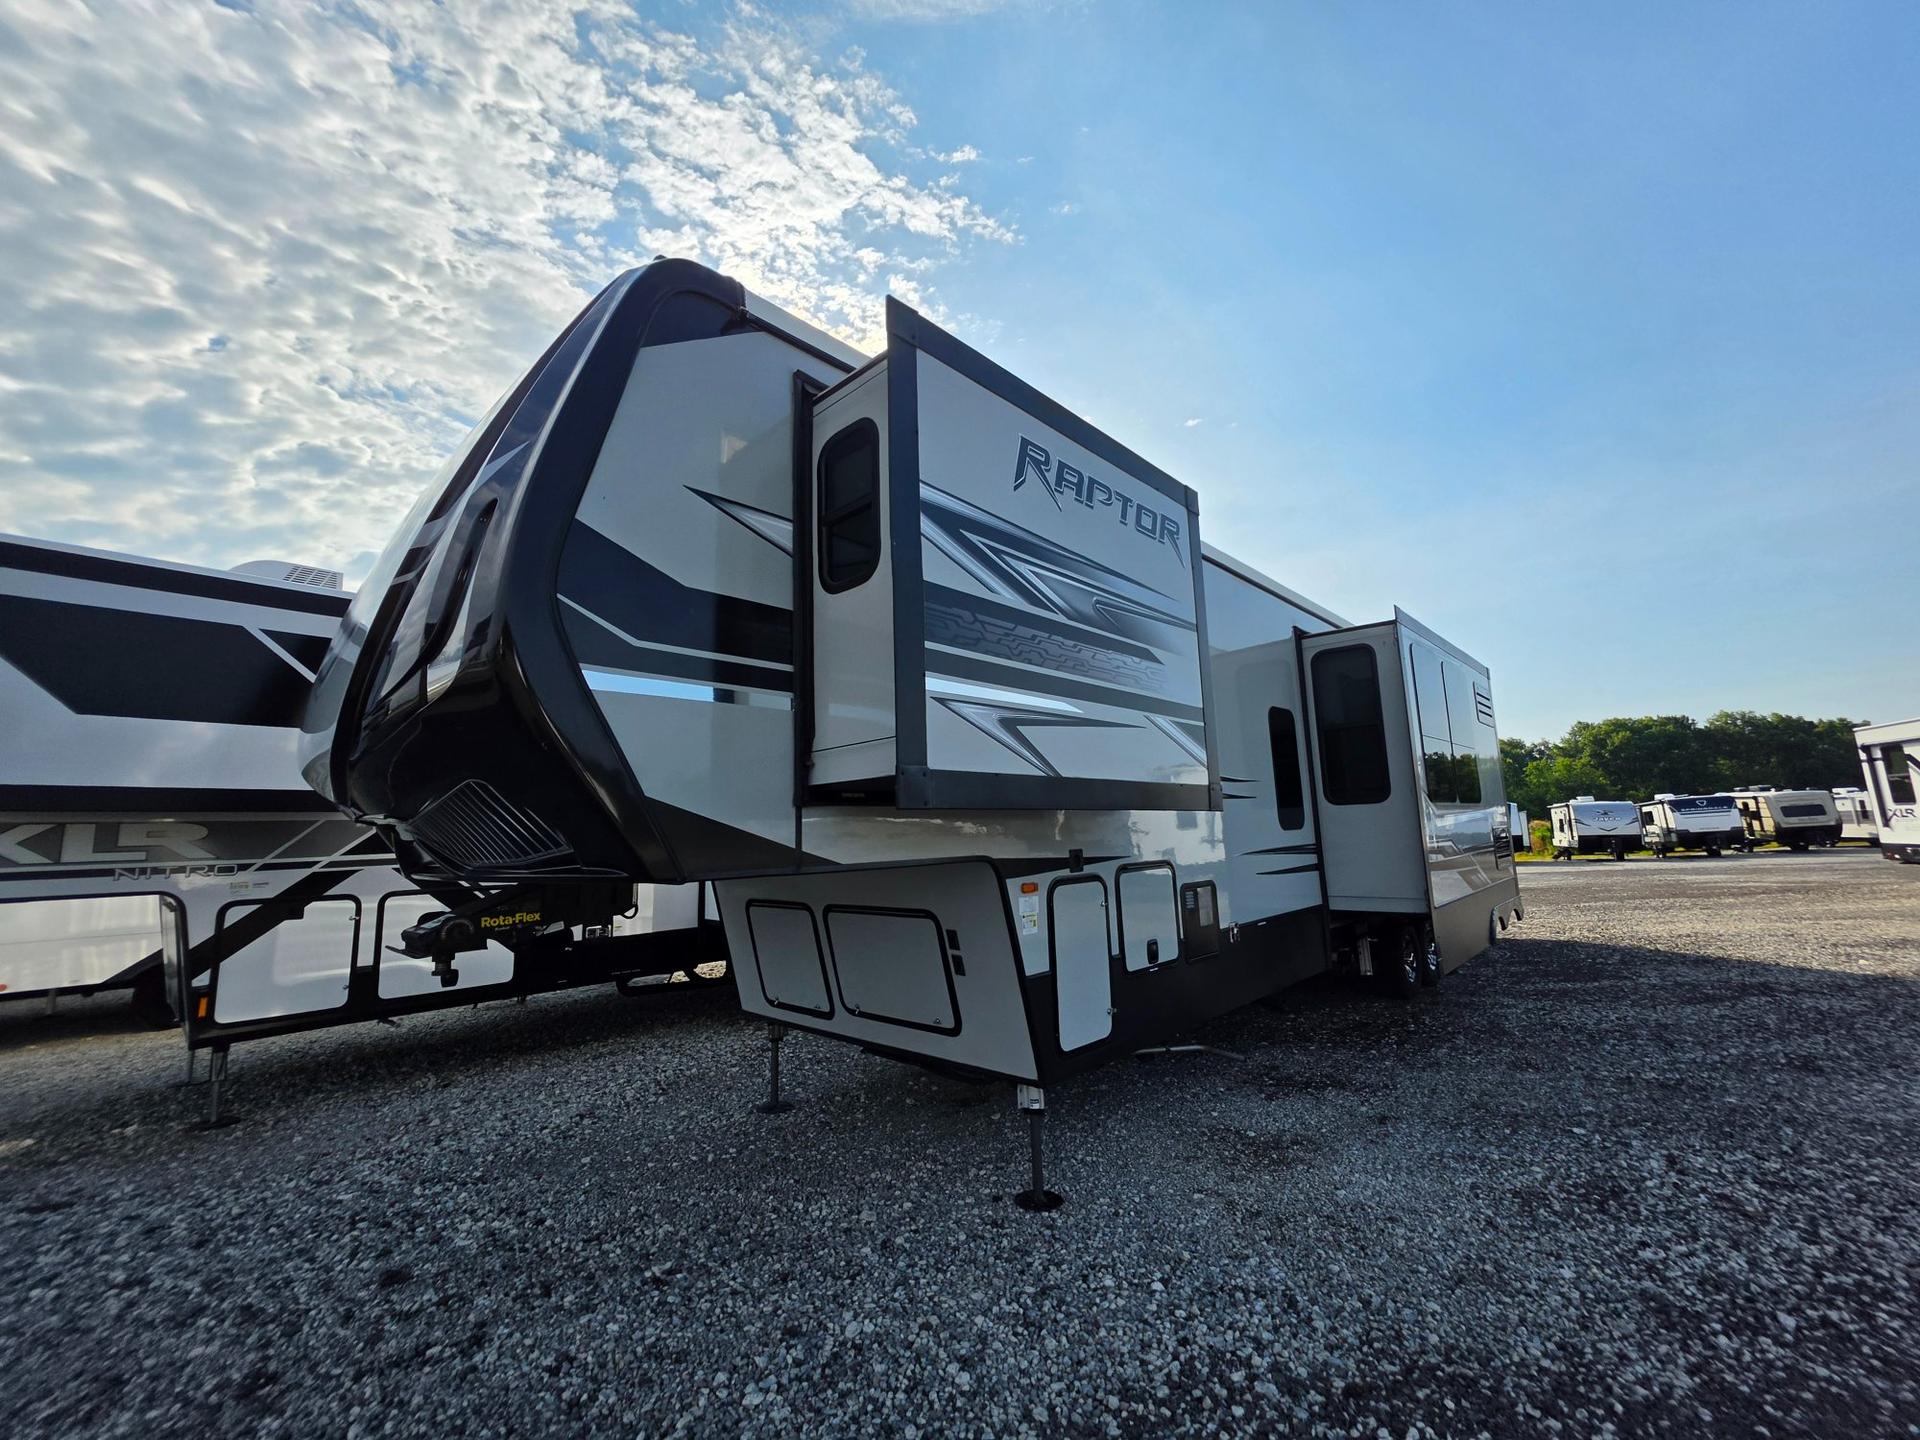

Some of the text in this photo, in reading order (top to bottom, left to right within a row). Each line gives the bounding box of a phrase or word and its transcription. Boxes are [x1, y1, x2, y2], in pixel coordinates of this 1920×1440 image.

[1013, 433, 1185, 569] RAPTOR
[1888, 808, 1917, 821] XLR
[113, 864, 239, 881] NITRO
